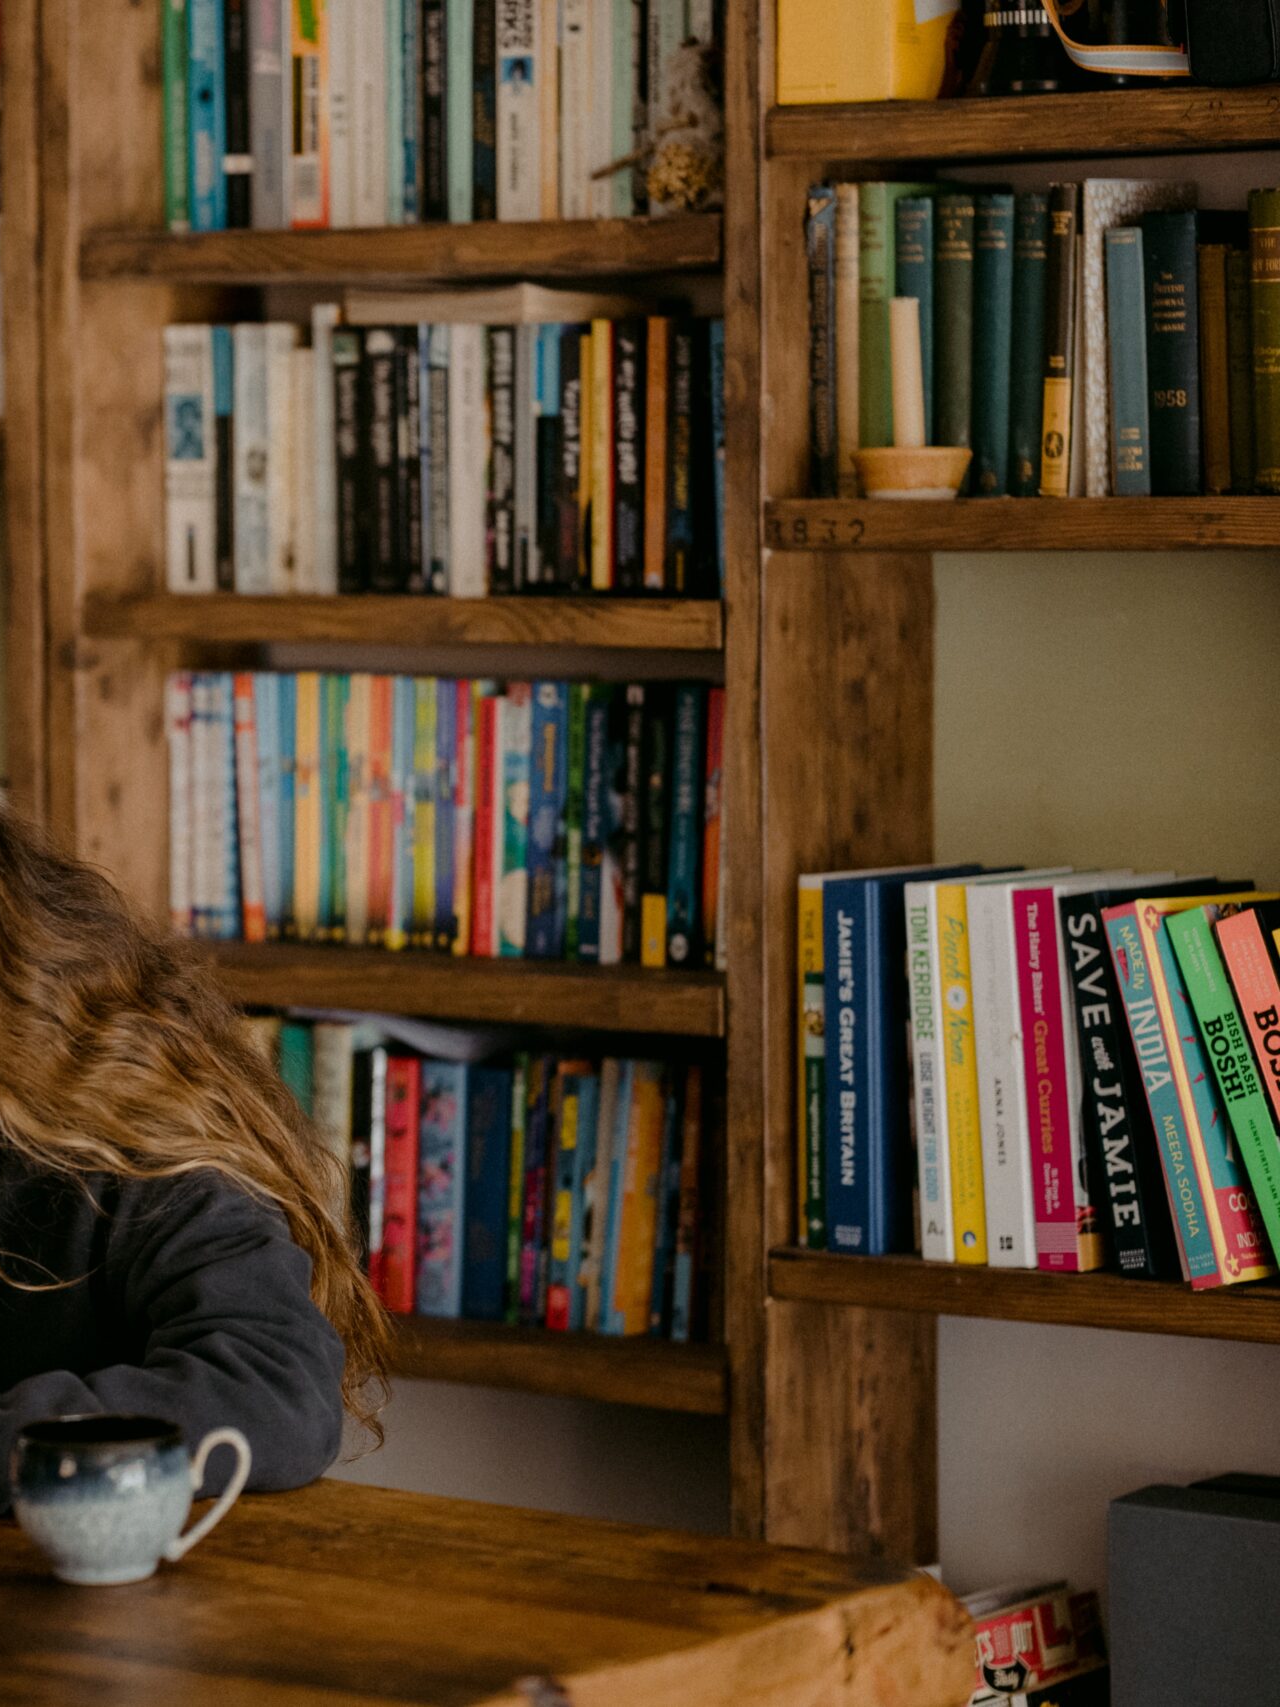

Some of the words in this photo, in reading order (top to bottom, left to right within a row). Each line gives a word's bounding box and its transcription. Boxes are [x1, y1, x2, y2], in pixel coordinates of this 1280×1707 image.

[910, 906, 929, 944] TOM
[1026, 902, 1039, 930] The
[1028, 931, 1041, 970] Hairy
[837, 909, 854, 1003] JAMIE'S
[1067, 912, 1112, 1029] SAVE
[1119, 924, 1145, 971] MADE
[1132, 975, 1146, 991] IN
[912, 950, 934, 1041] KERRIDGE
[838, 1007, 856, 1086] GREAT
[920, 1052, 934, 1082] LOSE
[1033, 1019, 1050, 1075] Great
[1090, 1035, 1117, 1071] with
[1127, 997, 1173, 1095] INDIA
[1203, 1015, 1246, 1102] BOSH!
[1223, 1011, 1244, 1050] BISH
[1236, 1051, 1259, 1097] BASH
[922, 1087, 936, 1135] WEIGHT
[994, 1077, 1003, 1117] ANNA
[1037, 1079, 1055, 1154] Curries
[839, 1091, 856, 1186] BRITAIN
[997, 1123, 1007, 1167] JONES
[1093, 1077, 1141, 1228] JAMIE
[1248, 1119, 1262, 1147] HENRY
[1258, 1148, 1271, 1175] FIRTH
[1162, 1114, 1186, 1176] MEERA
[1177, 1176, 1201, 1239] SODHA
